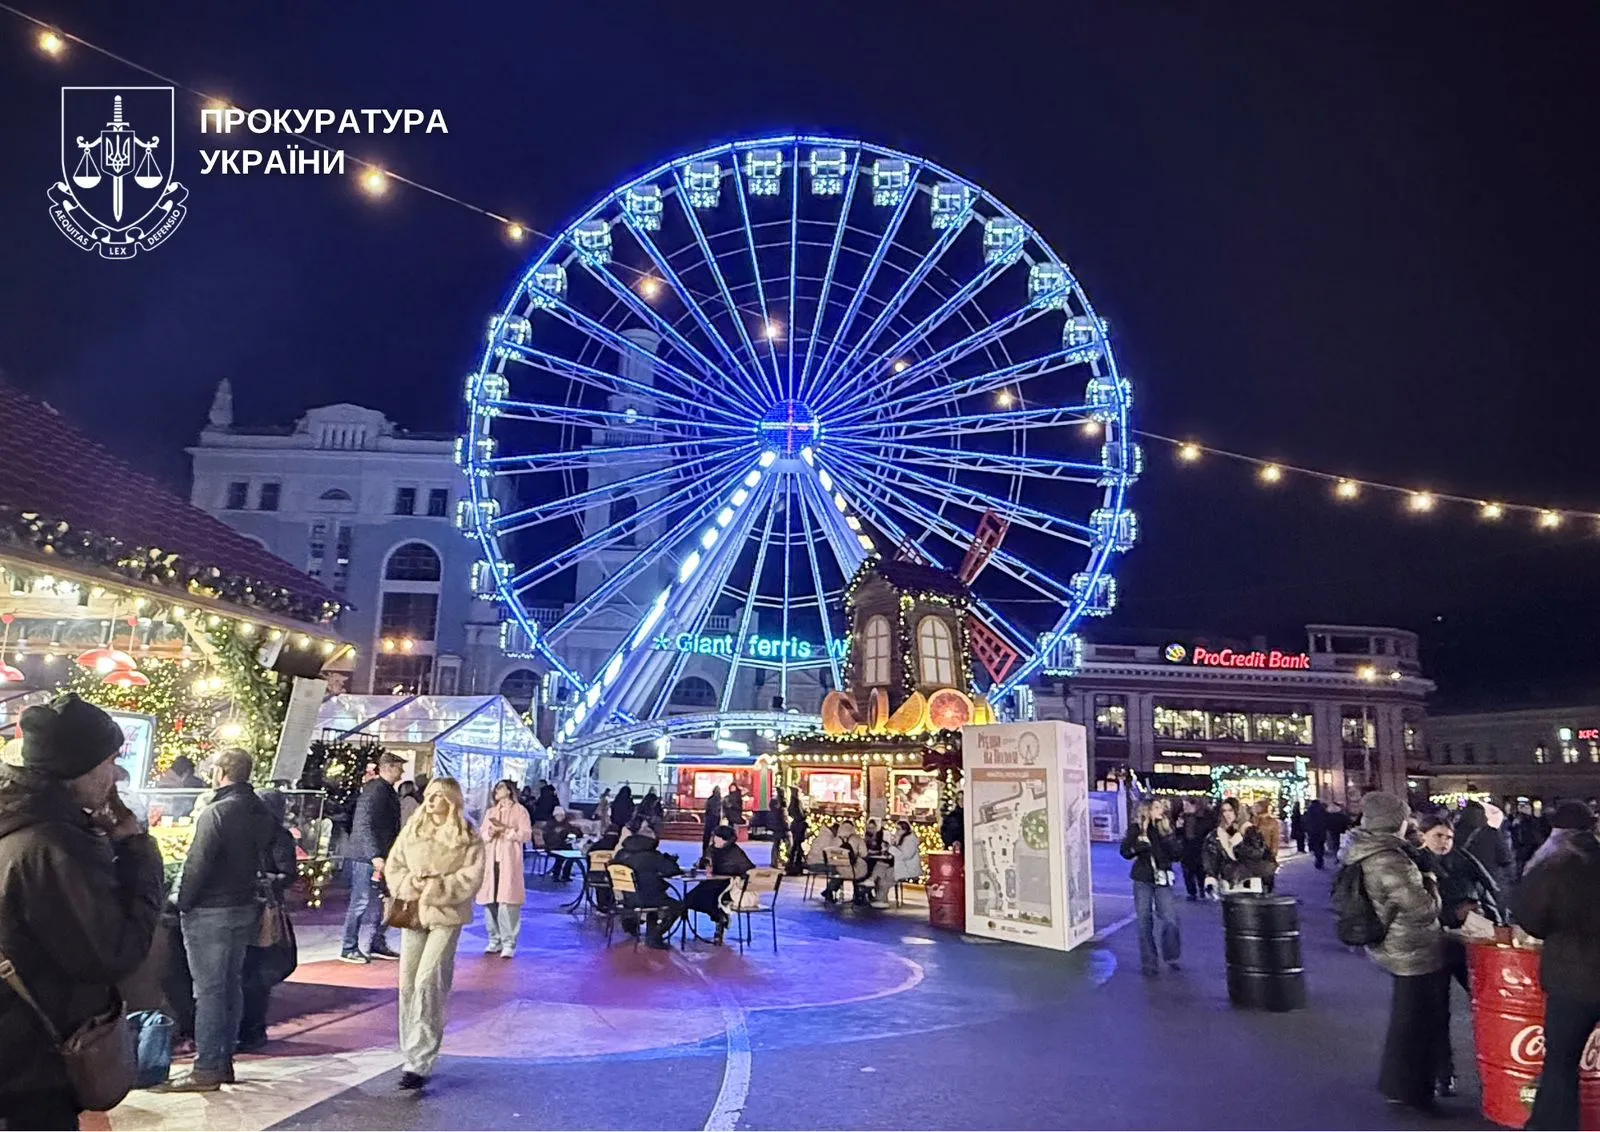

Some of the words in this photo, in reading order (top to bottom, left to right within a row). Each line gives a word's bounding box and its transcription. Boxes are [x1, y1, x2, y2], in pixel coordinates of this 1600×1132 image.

[675, 632, 733, 654] Giant
[748, 634, 811, 658] ferris
[1192, 646, 1266, 669] ProCredit
[1268, 650, 1310, 669] Bank
